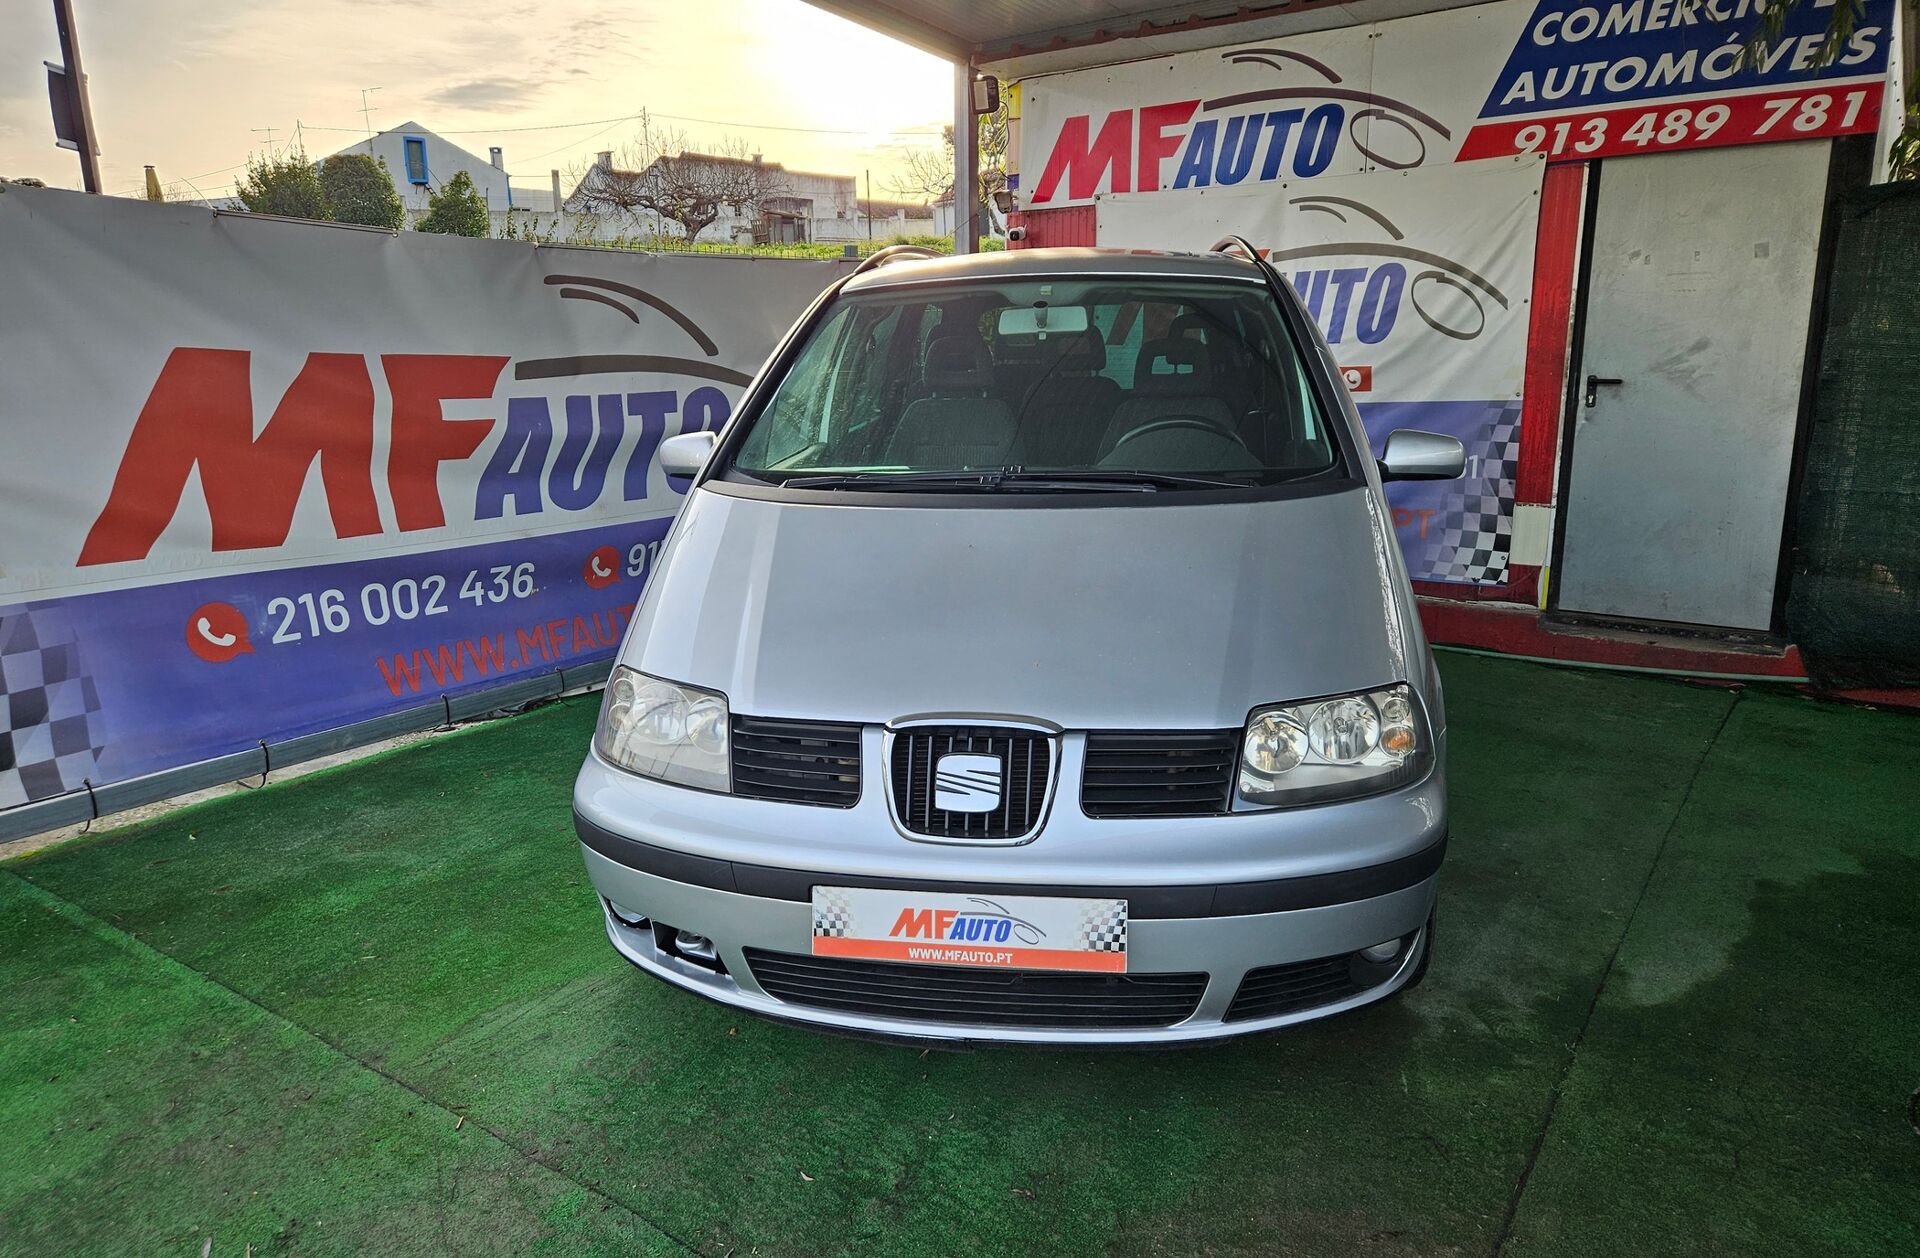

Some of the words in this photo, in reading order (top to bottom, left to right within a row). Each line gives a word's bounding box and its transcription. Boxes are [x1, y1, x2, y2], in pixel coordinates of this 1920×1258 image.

[1514, 117, 1609, 156] 913
[1621, 104, 1731, 147] 489
[1752, 90, 1867, 136] 781
[267, 588, 350, 644] 216
[360, 575, 449, 626] 002
[459, 562, 536, 607] 436
[627, 540, 662, 577] 91
[908, 947, 1013, 964] WWW.MFAUTO.PT
